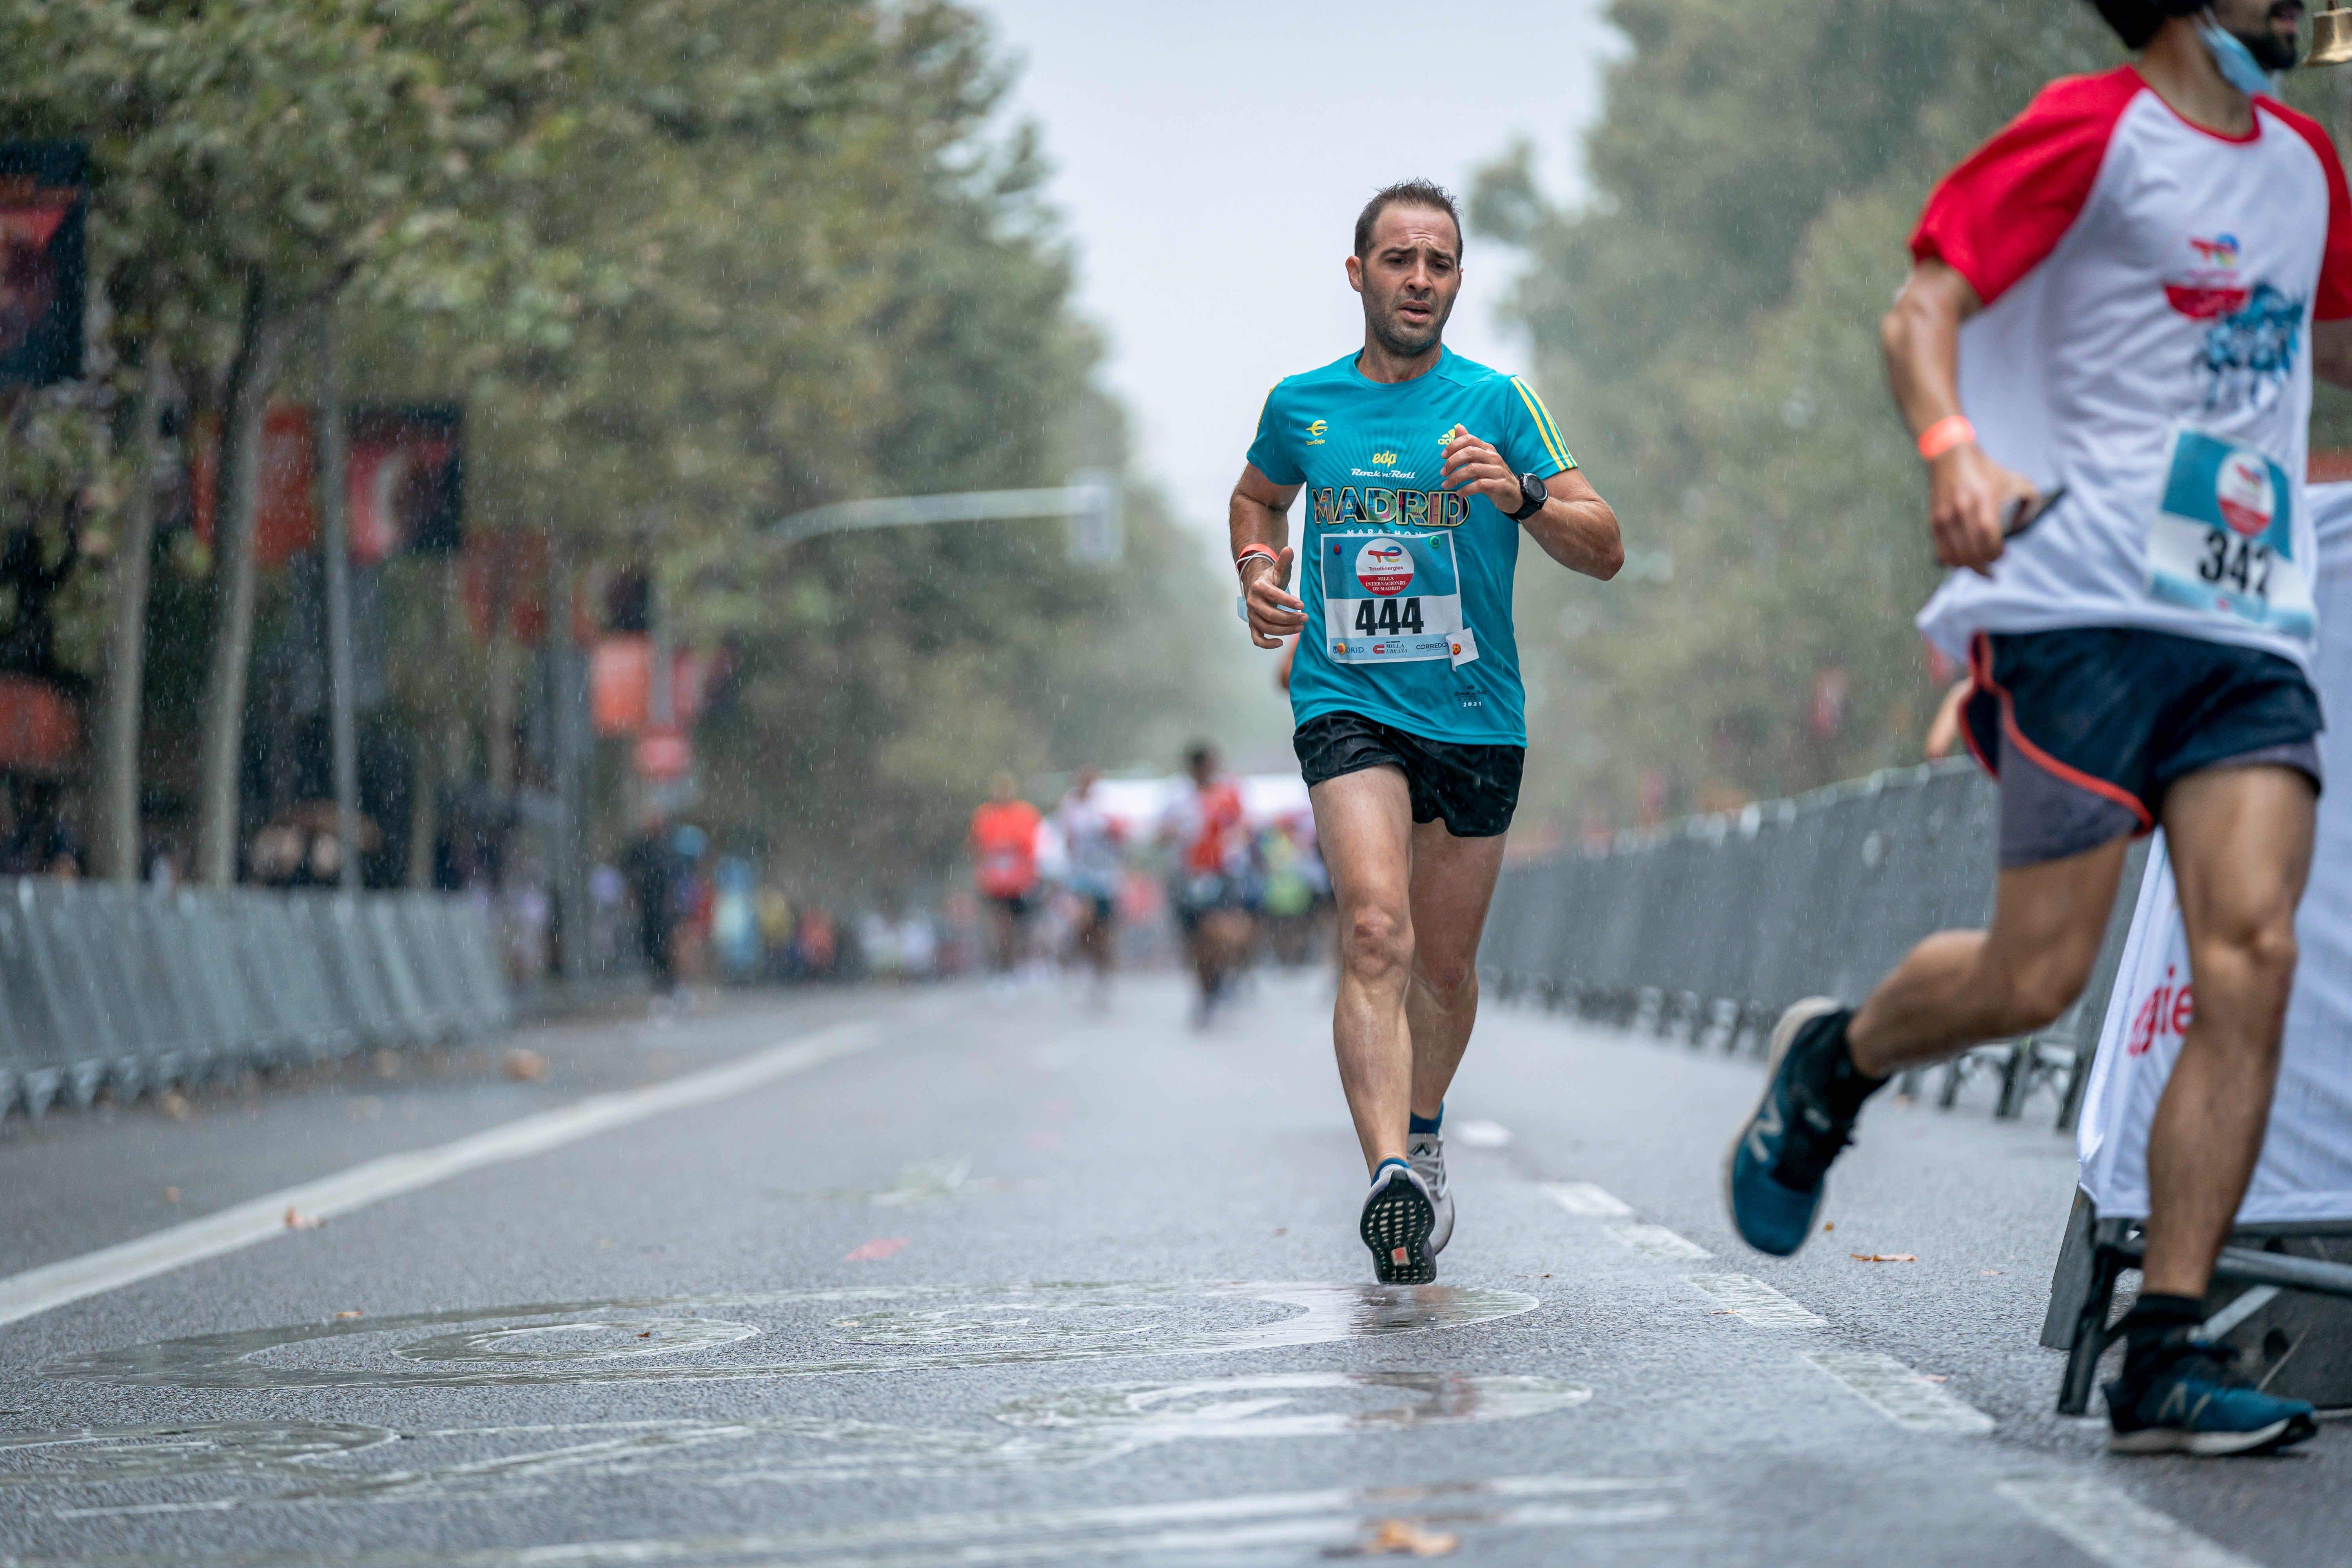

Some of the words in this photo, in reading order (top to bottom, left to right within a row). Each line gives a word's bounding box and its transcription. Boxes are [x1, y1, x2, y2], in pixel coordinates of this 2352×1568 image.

[1372, 450, 1397, 467] edp
[1351, 468, 1381, 477] Rock
[1391, 470, 1415, 479] Roll
[1311, 486, 1470, 526] MADRID
[1356, 597, 1424, 636] 444
